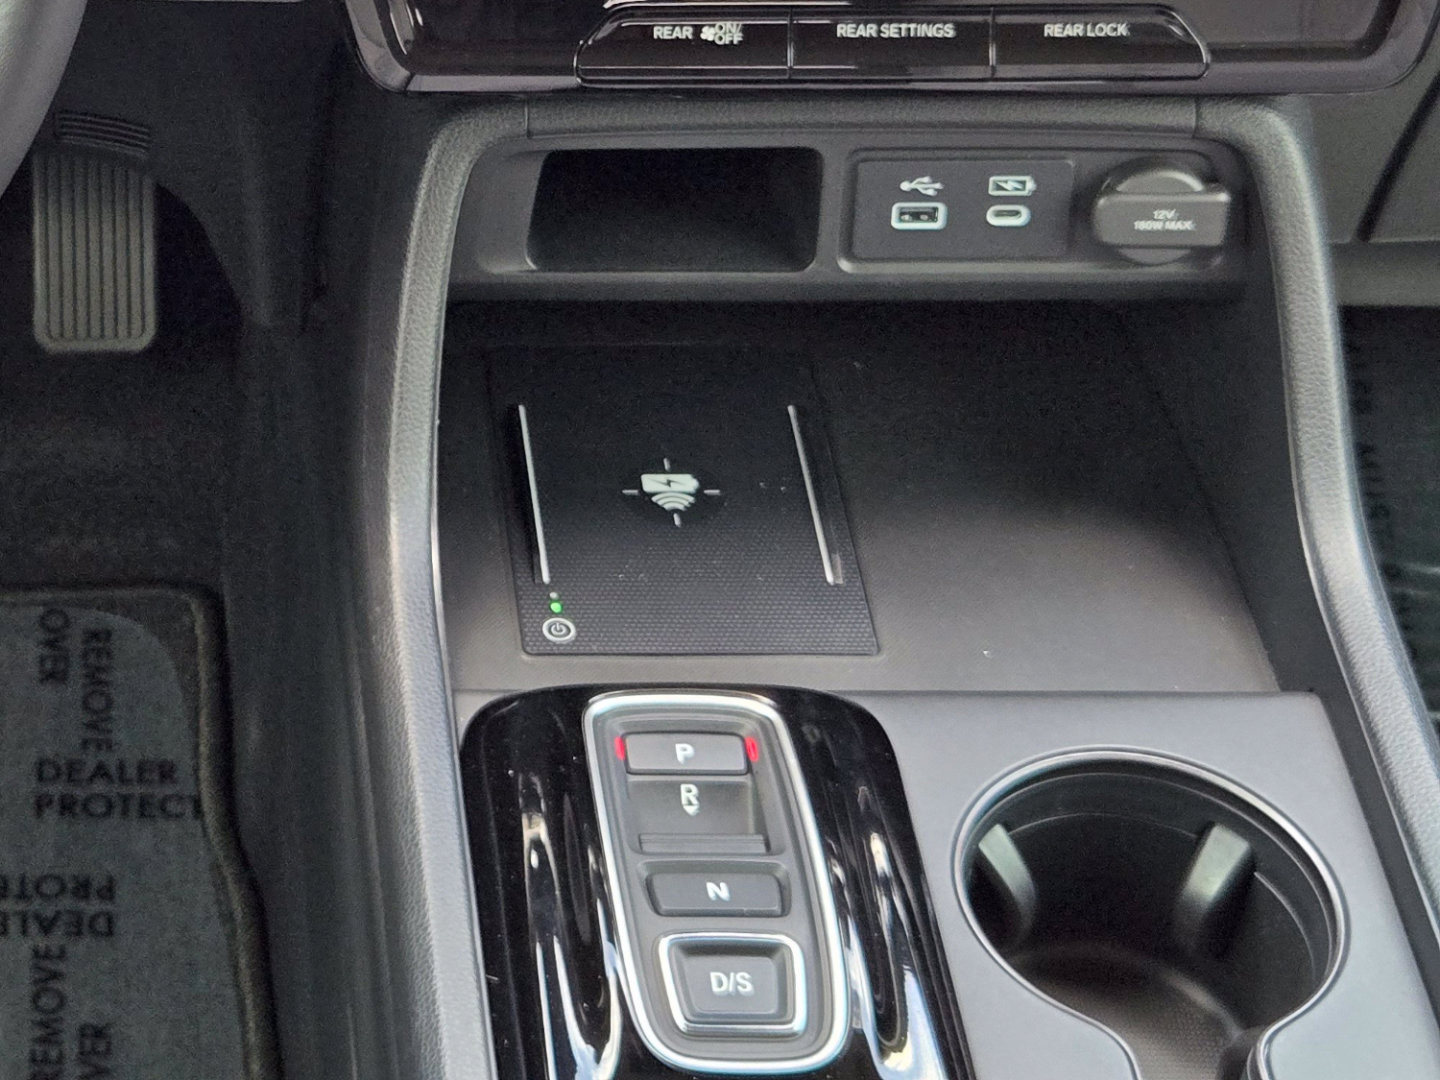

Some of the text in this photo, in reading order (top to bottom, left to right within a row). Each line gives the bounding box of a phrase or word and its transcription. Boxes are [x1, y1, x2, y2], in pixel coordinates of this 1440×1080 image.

[652, 25, 694, 40] REAR
[714, 33, 744, 46] OFF
[836, 22, 957, 39] REAR SETTINGS
[1043, 22, 1130, 38] REAR LOCK
[1152, 208, 1177, 220] 12V
[36, 606, 72, 685] OVER
[80, 628, 115, 752] REMOVE
[675, 742, 696, 764] P
[34, 757, 181, 786] DEALER
[33, 791, 204, 820] PROTECT
[680, 782, 700, 806] R
[705, 881, 731, 902] N
[709, 970, 754, 996] D/S
[76, 1021, 117, 1080] VER
